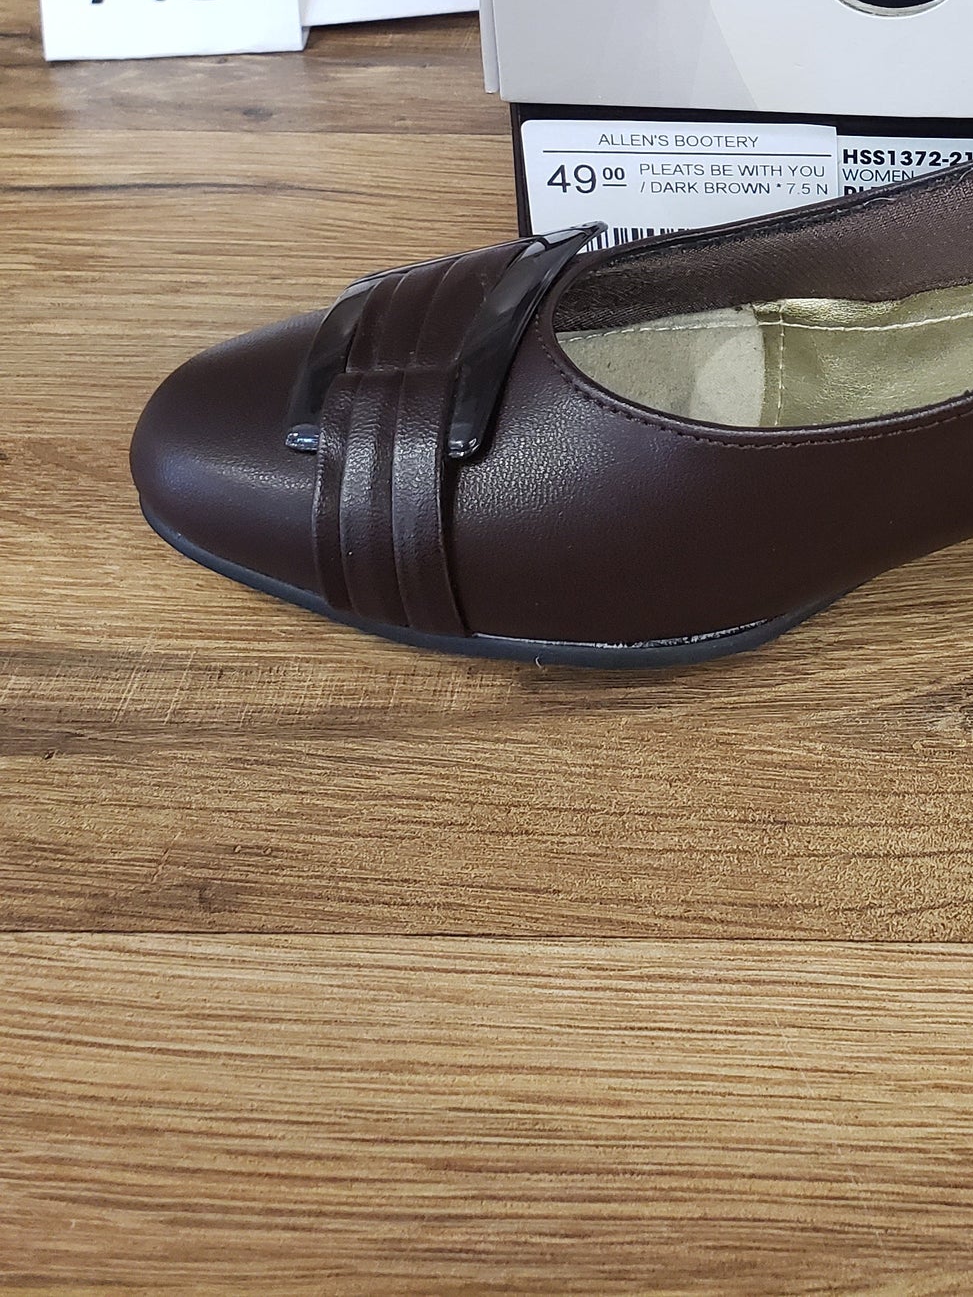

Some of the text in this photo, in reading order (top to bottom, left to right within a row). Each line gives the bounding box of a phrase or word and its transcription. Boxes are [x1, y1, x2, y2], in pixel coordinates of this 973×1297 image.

[598, 133, 759, 148] ALLEN'S BOOTERY
[639, 163, 826, 178] PLEATS BE WITH YOU
[841, 168, 915, 183] WOMEN
[546, 164, 626, 194] 49 00
[651, 181, 699, 194] DARK
[704, 182, 771, 195] BROWN
[786, 182, 811, 195] 7.5
[816, 183, 829, 196] N
